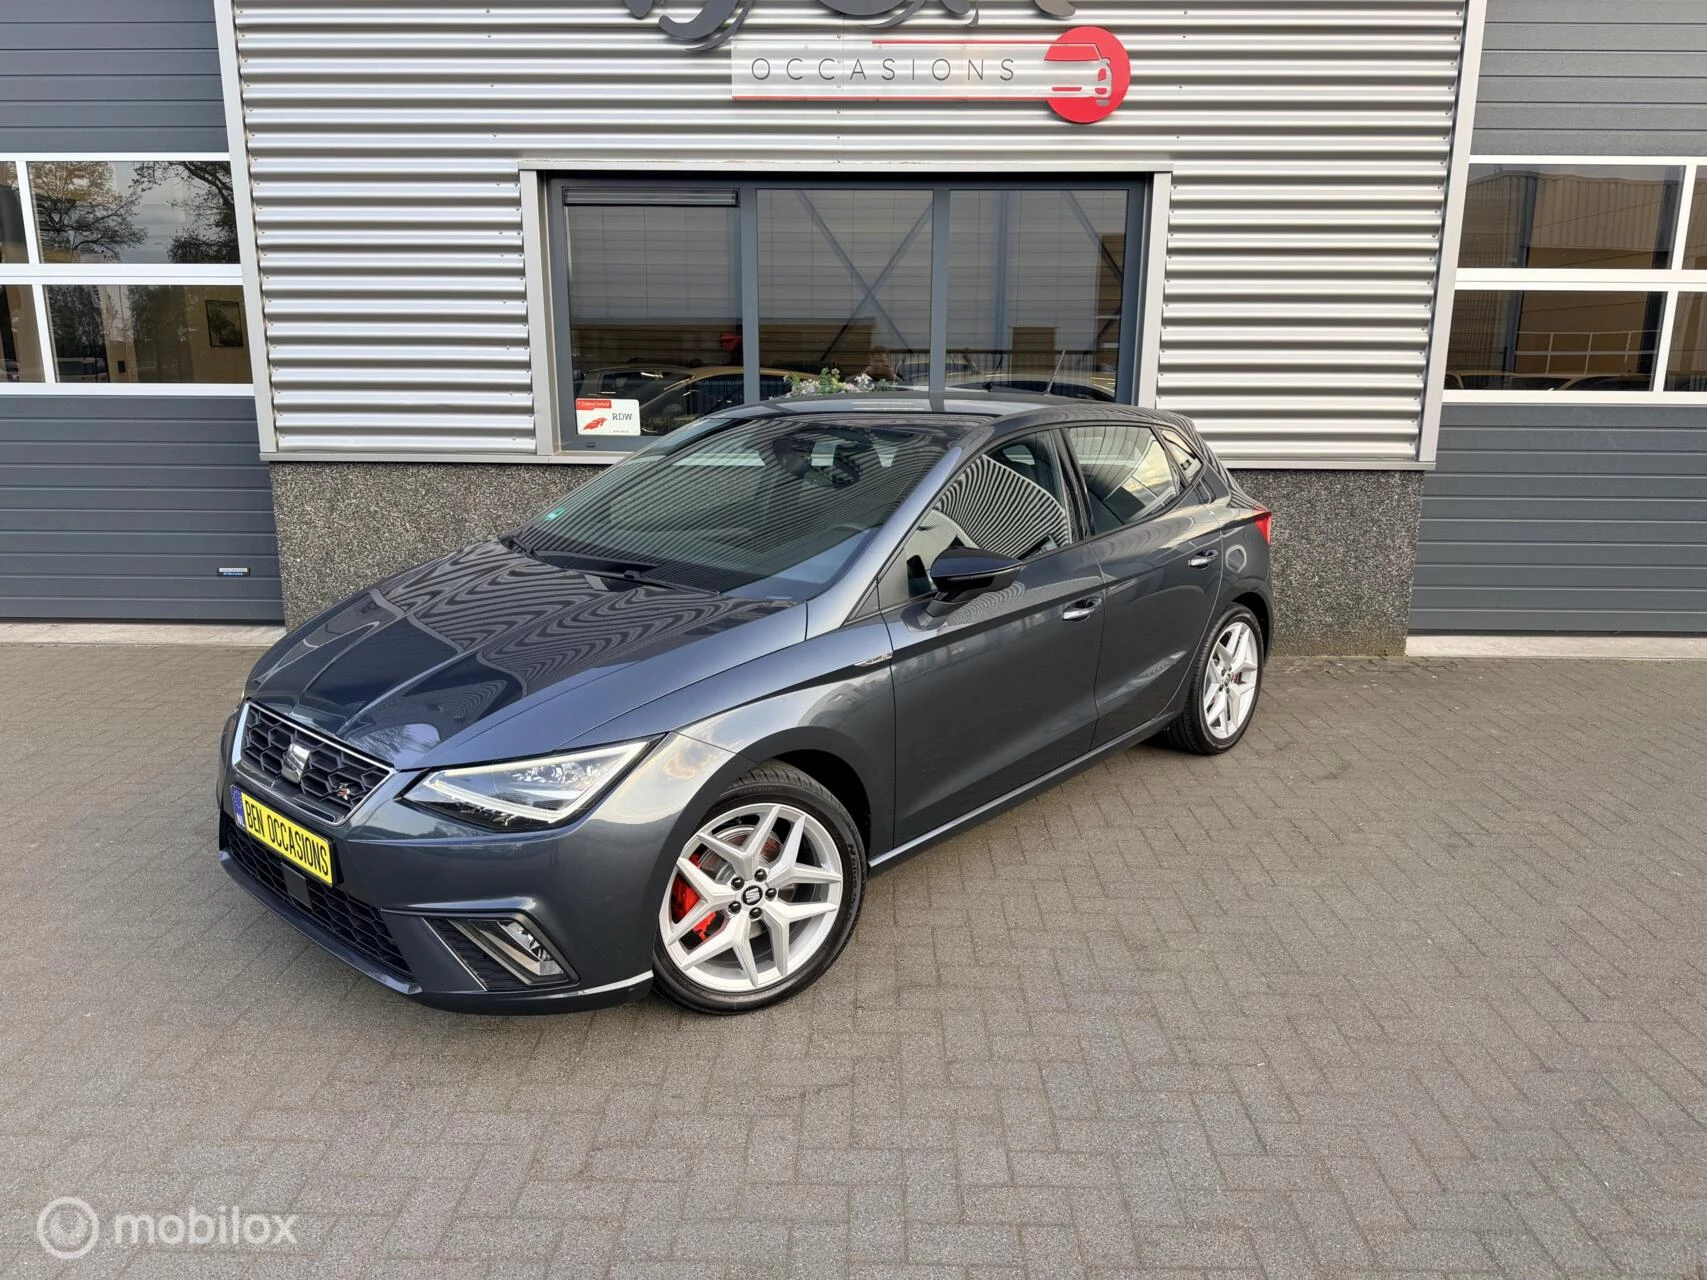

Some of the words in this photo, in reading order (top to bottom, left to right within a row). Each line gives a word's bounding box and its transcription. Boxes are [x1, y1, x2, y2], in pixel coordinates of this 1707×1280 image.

[751, 57, 1015, 81] OCCASIONS
[612, 413, 633, 421] RDW
[244, 799, 265, 838] BEN
[267, 814, 329, 876] OCCASIONS
